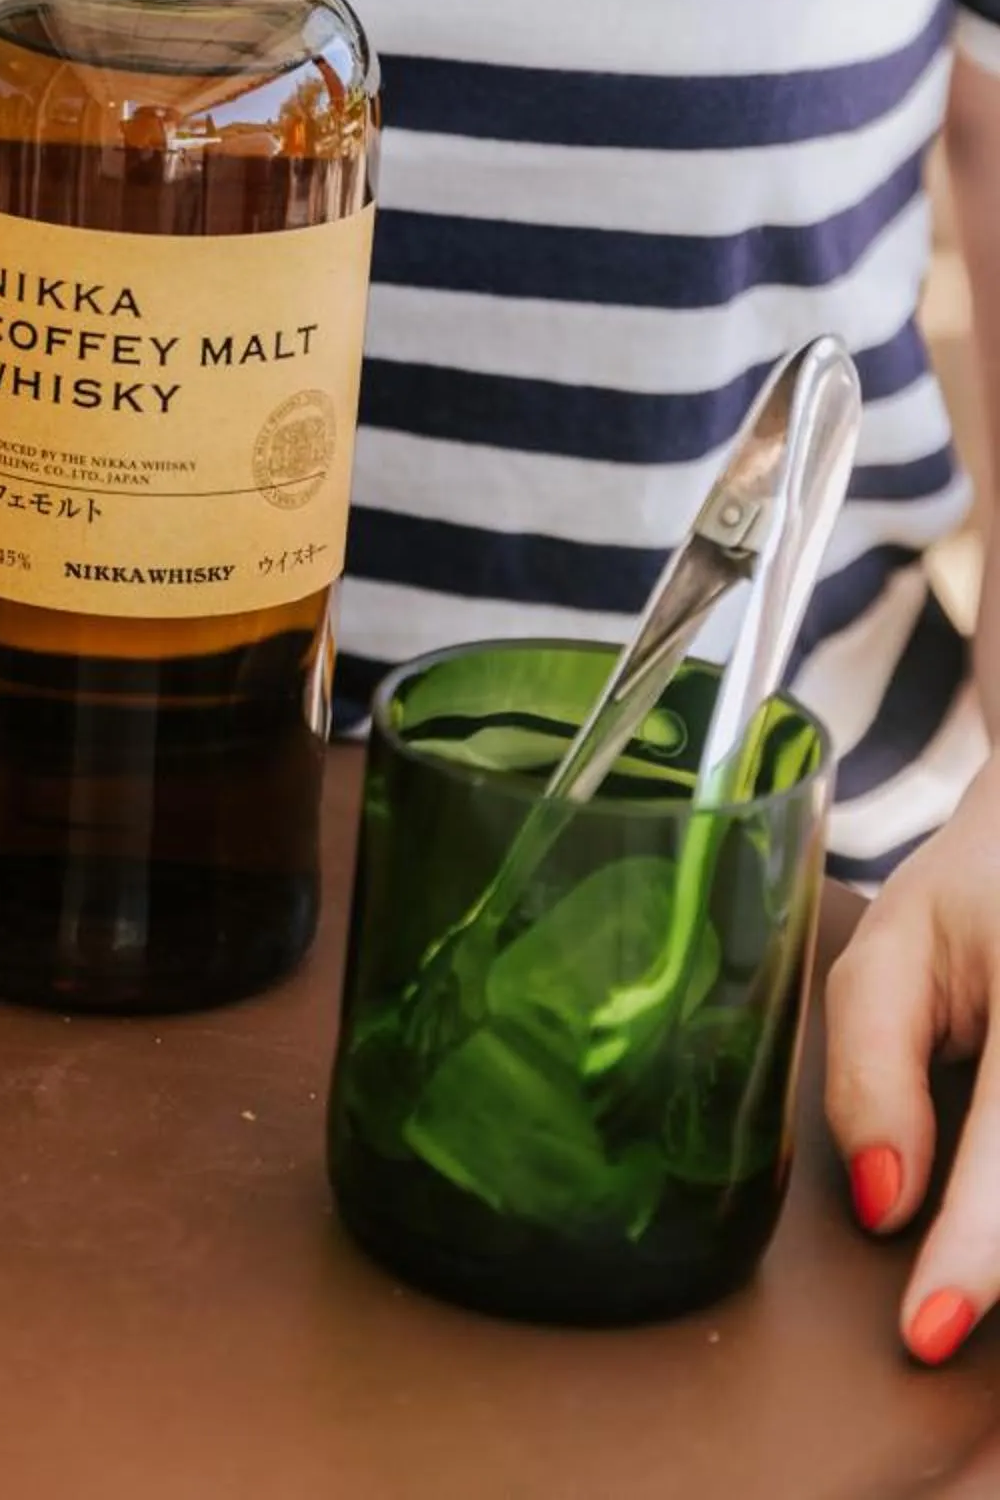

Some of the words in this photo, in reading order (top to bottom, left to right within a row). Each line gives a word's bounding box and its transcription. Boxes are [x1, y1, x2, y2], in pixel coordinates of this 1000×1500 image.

[199, 324, 319, 367] MALT
[41, 448, 58, 461] BY
[61, 452, 88, 466] THE
[91, 455, 138, 471] NIKKA
[140, 459, 198, 473] WHISKY
[258, 543, 328, 575] ウイスキー
